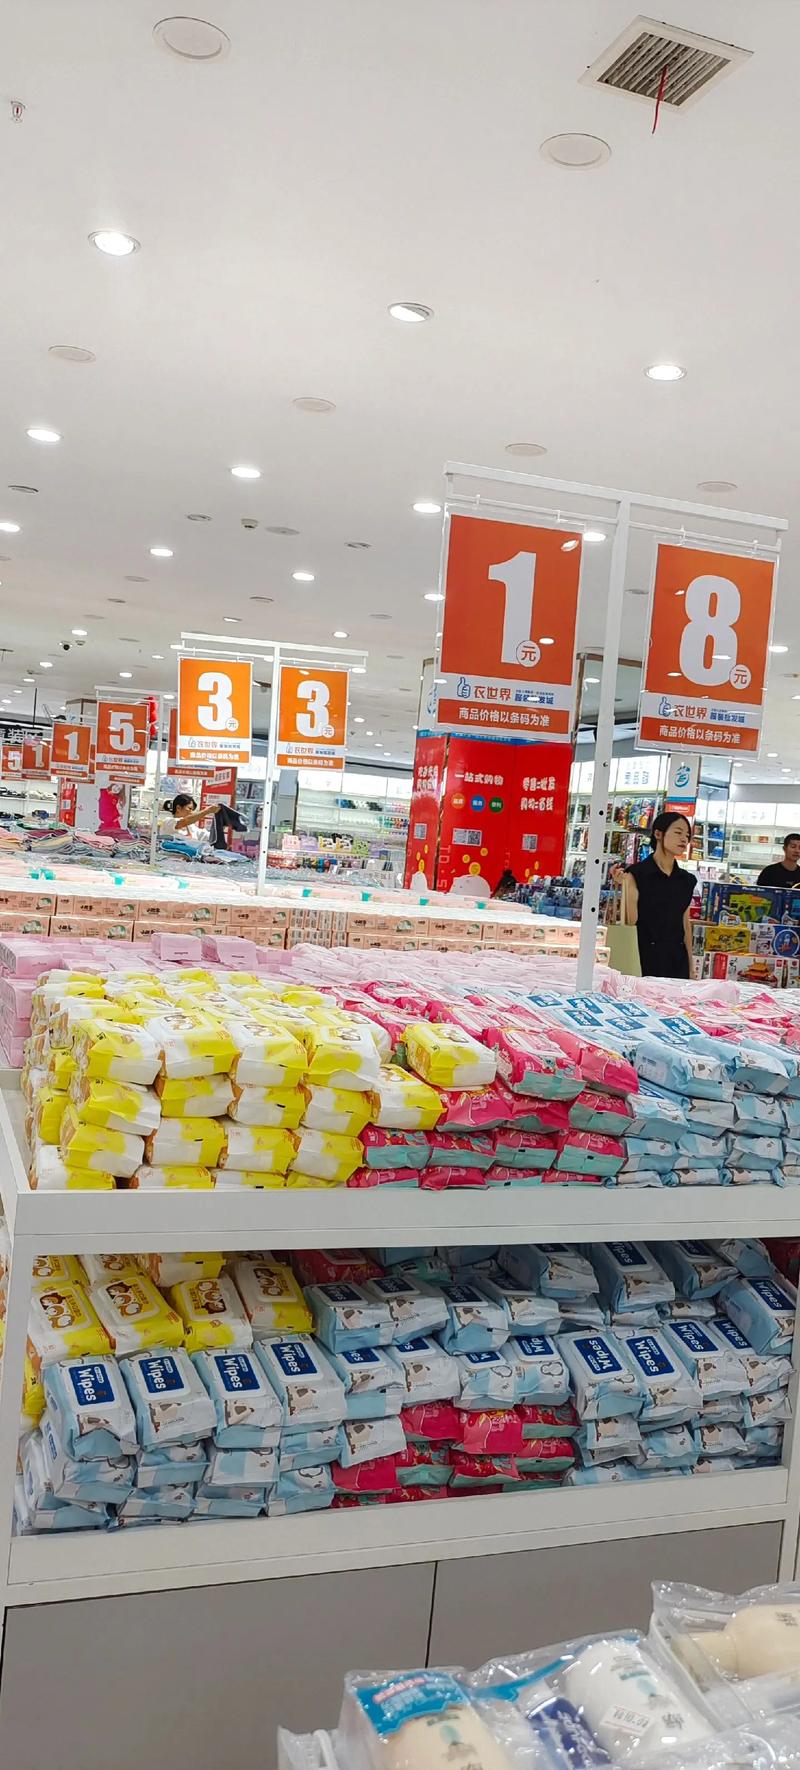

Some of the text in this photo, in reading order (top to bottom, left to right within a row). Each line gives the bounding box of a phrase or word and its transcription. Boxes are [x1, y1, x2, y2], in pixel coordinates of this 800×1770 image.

[488, 551, 537, 665] 1
[679, 574, 741, 687] 8
[520, 646, 536, 662] 元
[733, 670, 748, 685] 元
[197, 671, 233, 731] 3
[474, 685, 511, 701] 衣世界
[295, 680, 330, 737] 3
[458, 707, 550, 727] 商品价格以条码为准
[674, 704, 707, 720] 衣世界
[109, 711, 135, 751] 5
[659, 725, 741, 744] 商品价格以条码为准
[7, 750, 21, 771] 5
[32, 744, 44, 768] 1
[64, 731, 79, 761] 1
[454, 772, 504, 786] 一站式购物
[757, 1280, 783, 1309] Wipes
[677, 1324, 704, 1351] Wipes
[721, 1321, 748, 1348] Wipes
[279, 1344, 301, 1374] Wipes
[587, 1339, 615, 1370] Wipes
[634, 1341, 659, 1373] Wipes
[76, 1368, 97, 1402] Wipes
[146, 1358, 167, 1391] Wipes
[223, 1357, 243, 1389] Wipes
